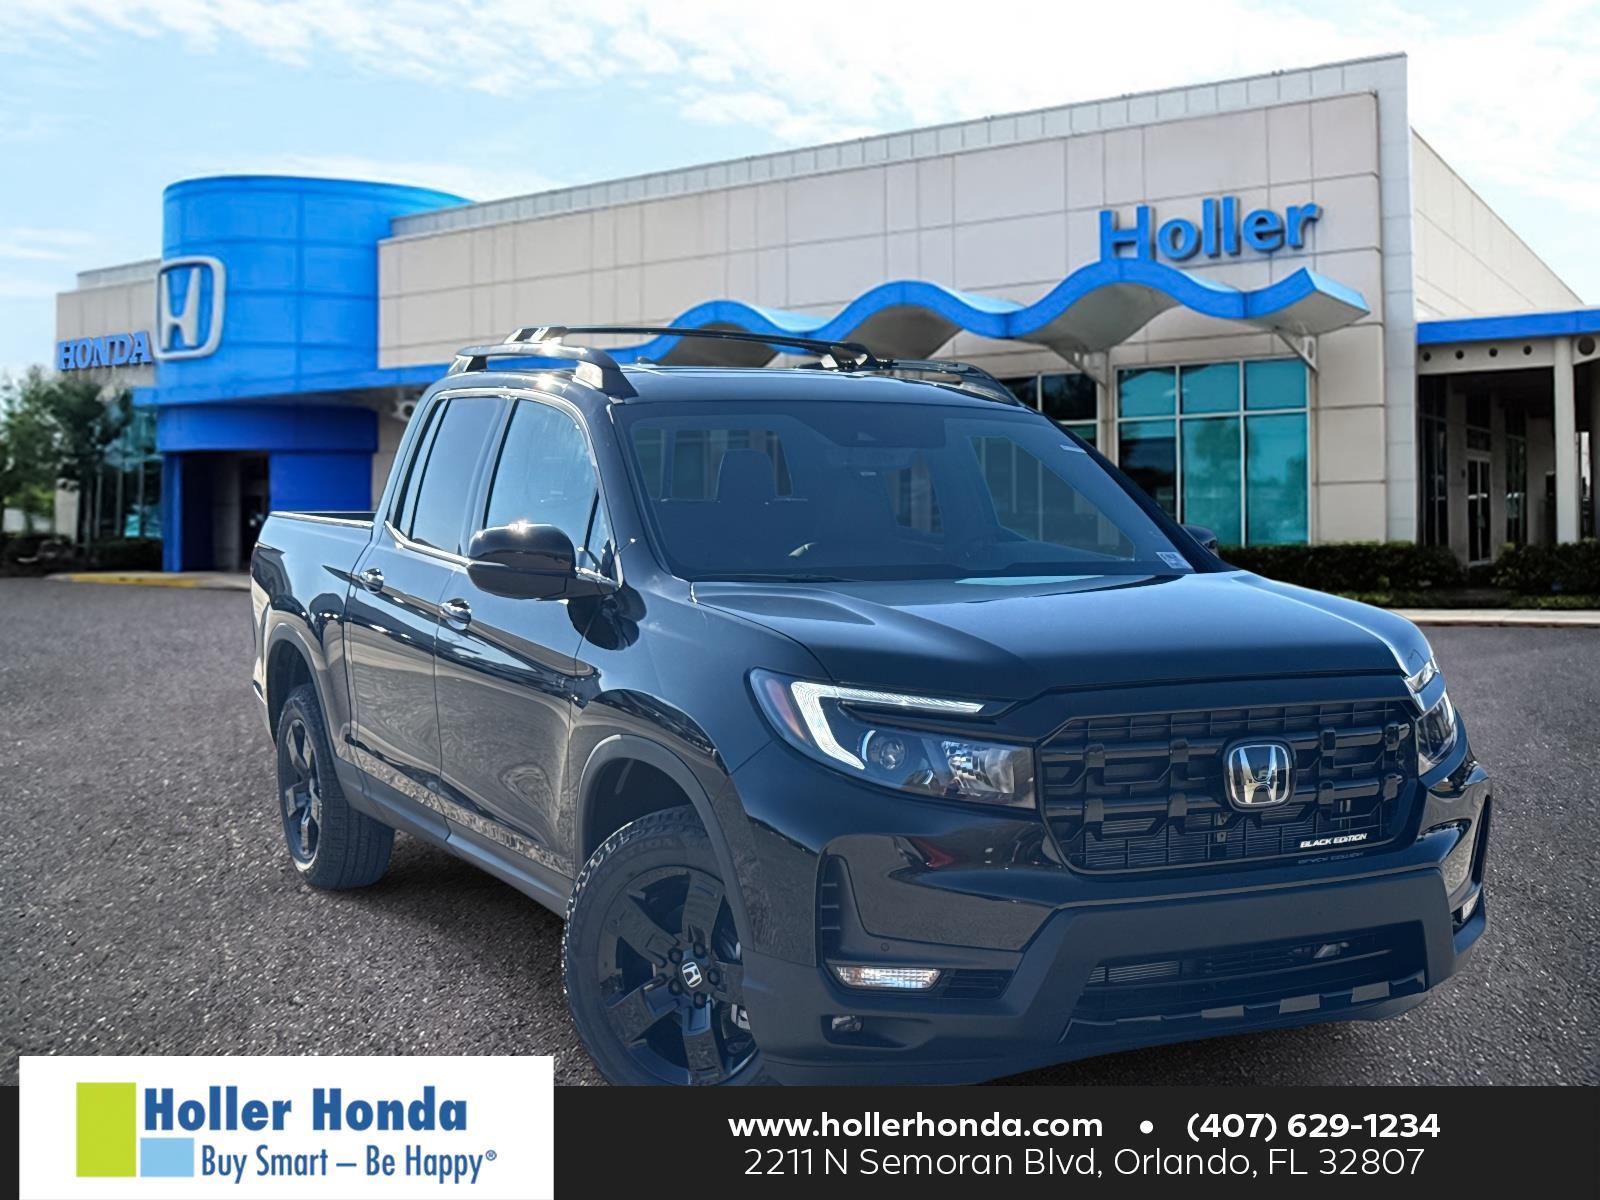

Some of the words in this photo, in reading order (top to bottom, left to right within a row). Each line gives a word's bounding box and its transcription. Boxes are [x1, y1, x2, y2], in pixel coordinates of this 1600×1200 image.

[1098, 195, 1322, 261] Holler
[58, 331, 154, 371] HONDA
[1300, 838, 1332, 848] BLACK
[1333, 833, 1368, 844] EDITION
